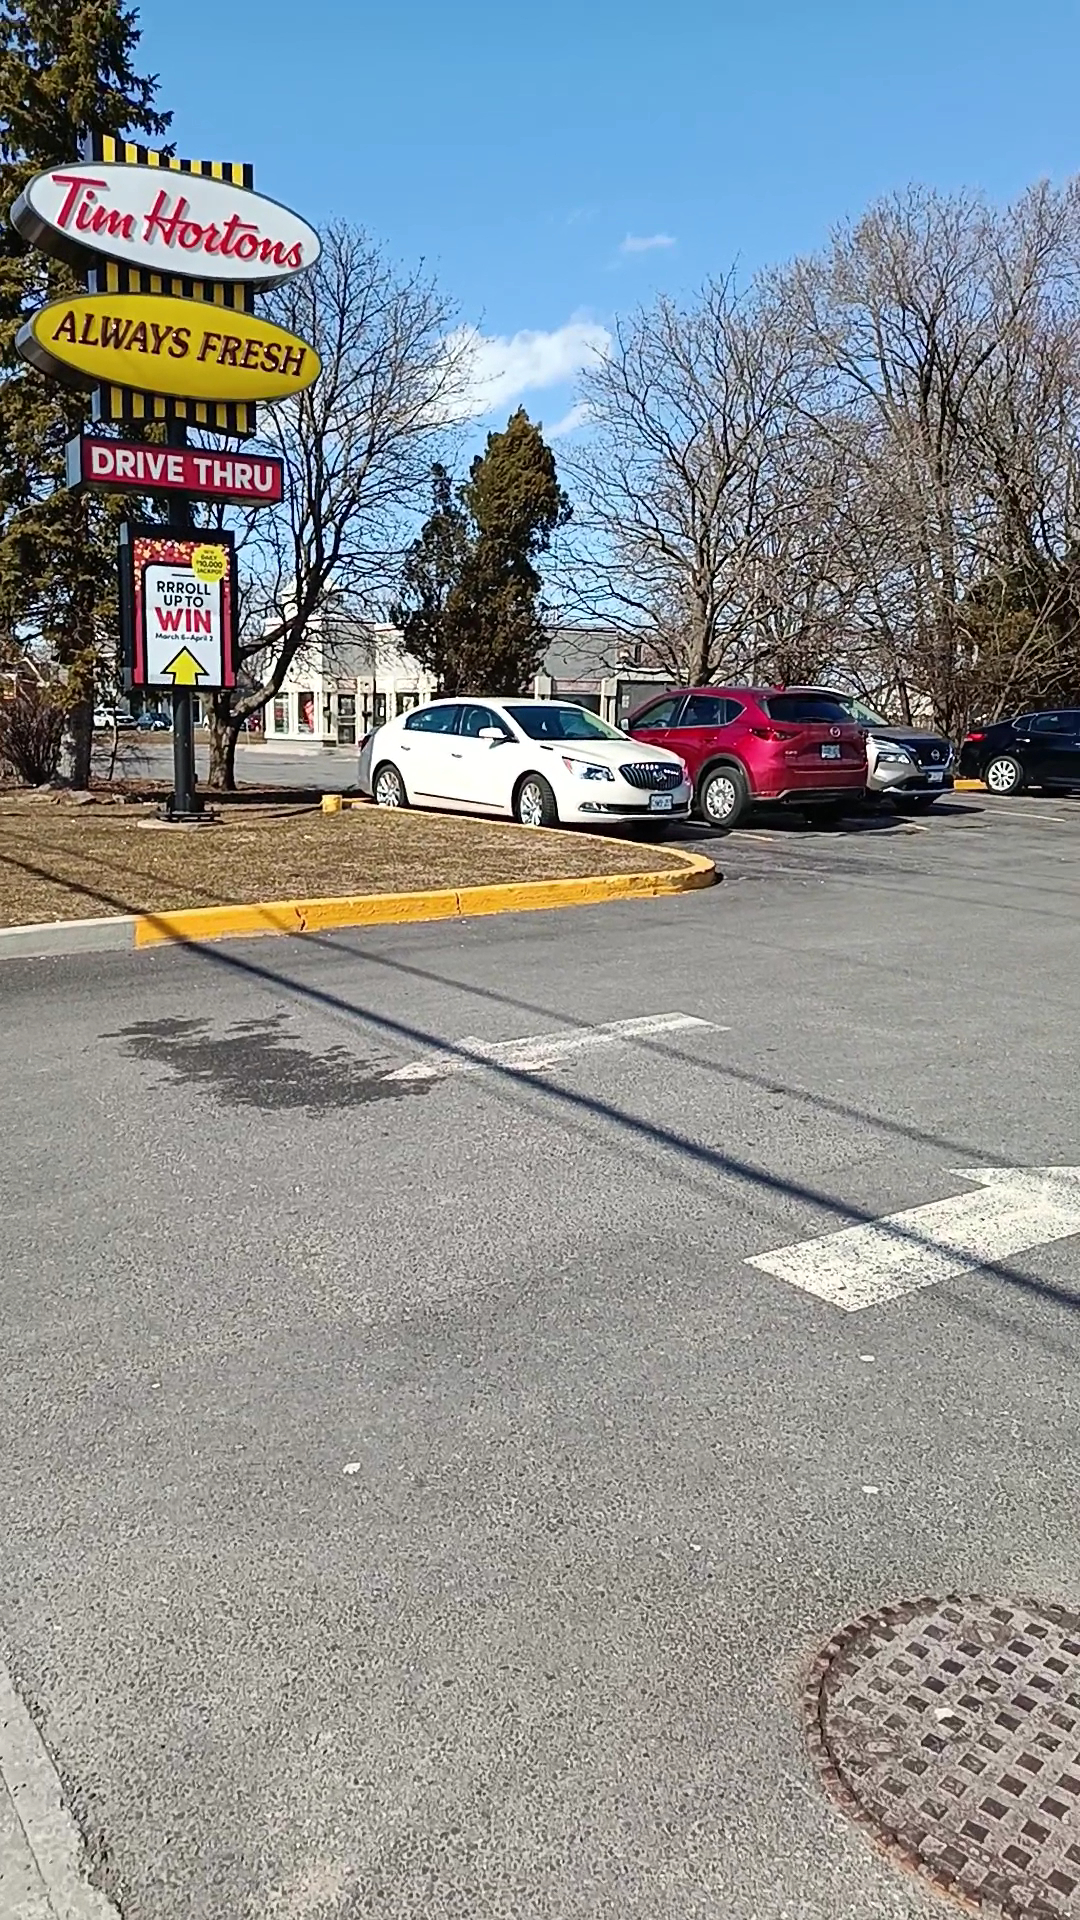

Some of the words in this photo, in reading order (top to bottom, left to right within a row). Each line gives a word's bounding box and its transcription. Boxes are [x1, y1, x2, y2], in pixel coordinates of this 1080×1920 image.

[51, 174, 134, 239] Tim
[143, 189, 303, 268] Hortons
[52, 310, 191, 358] ALWAYS
[196, 331, 307, 377] FRESH
[91, 446, 184, 483] DRIVE
[193, 458, 273, 492] THRU
[156, 581, 211, 595] RRROLL
[163, 595, 182, 606] UP
[185, 596, 204, 607] TO
[155, 607, 211, 633] WIN
